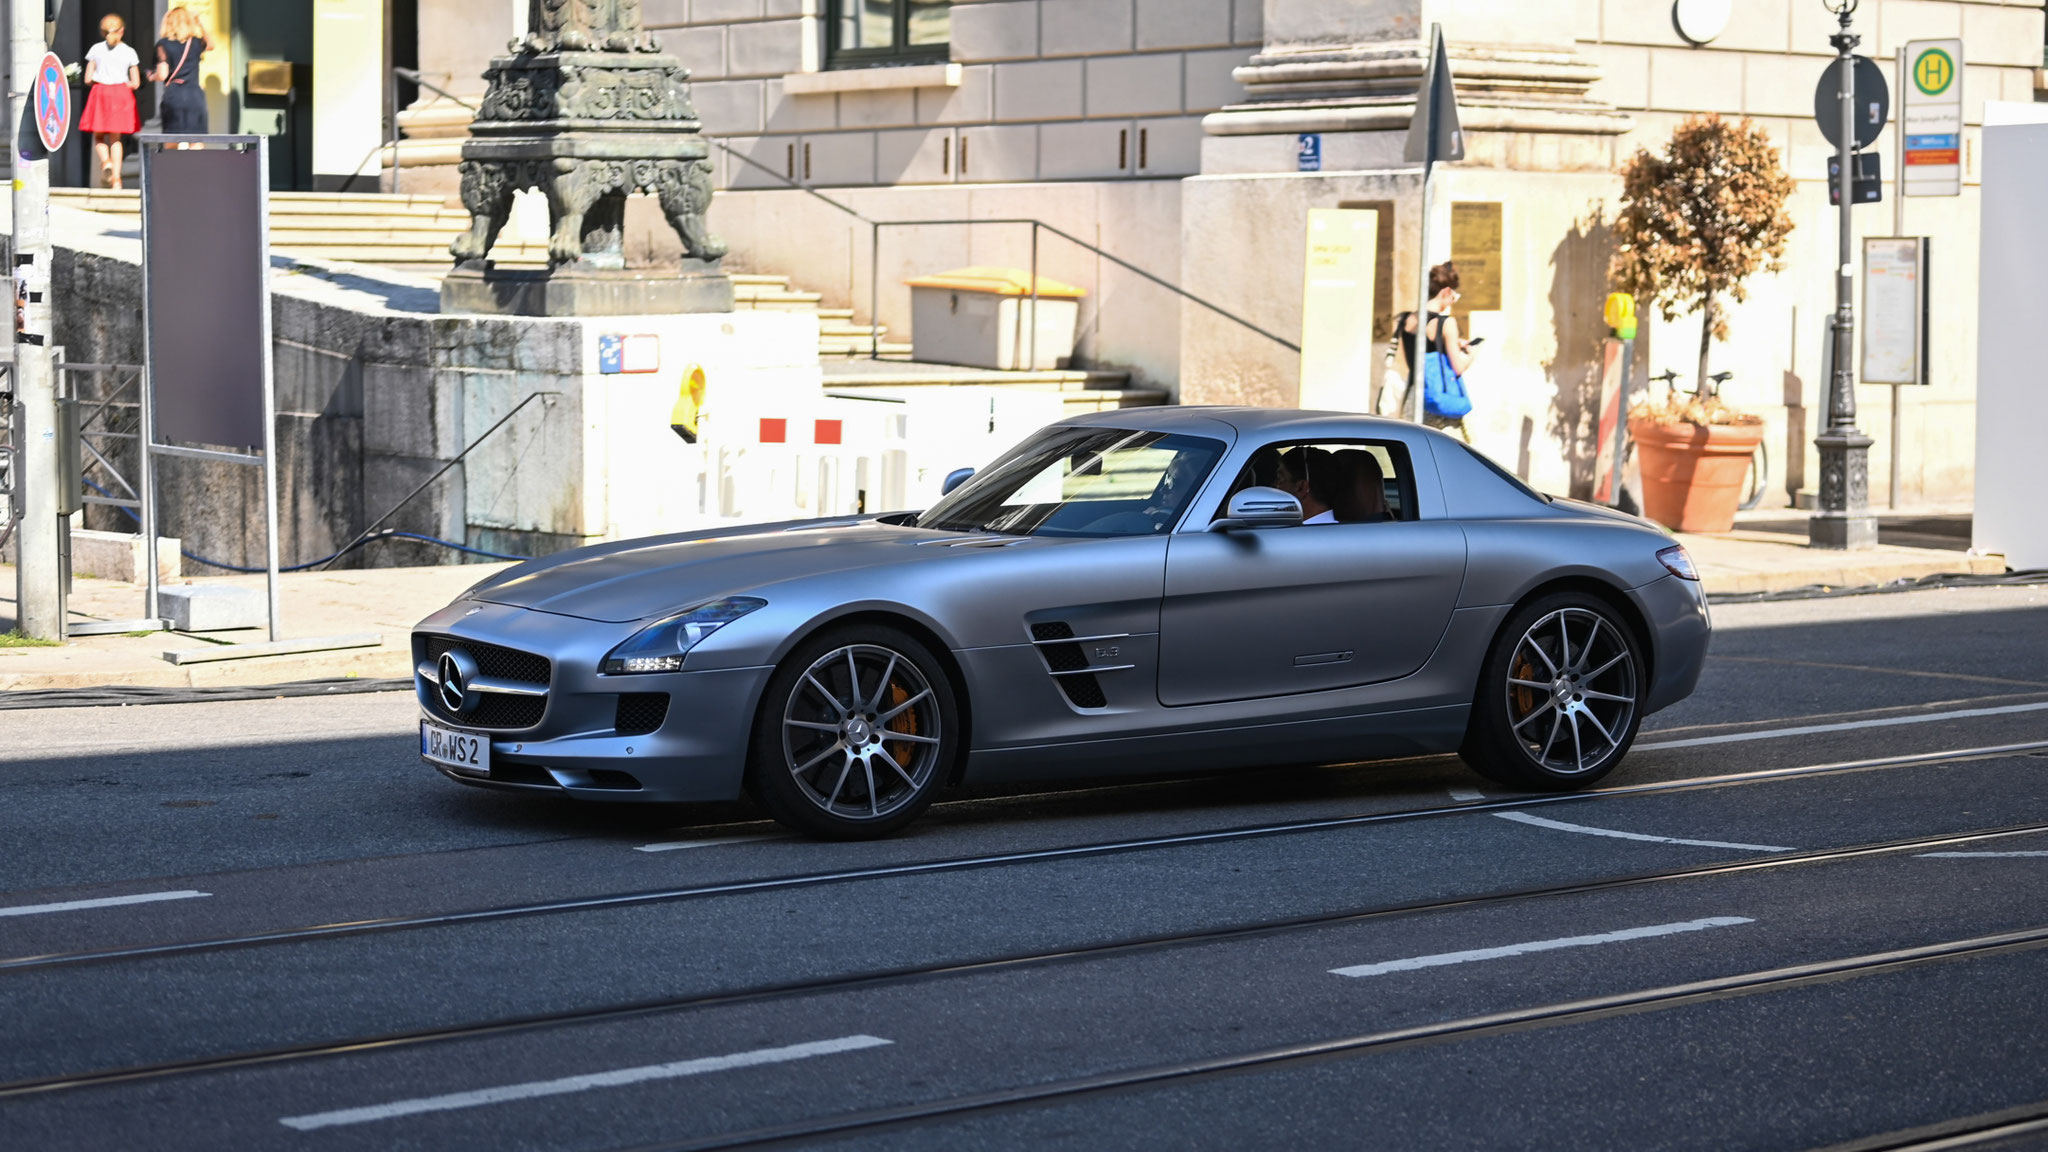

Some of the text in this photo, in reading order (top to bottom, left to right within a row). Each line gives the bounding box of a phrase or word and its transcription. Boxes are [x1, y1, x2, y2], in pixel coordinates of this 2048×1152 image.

[1925, 59, 1942, 85] H
[1303, 136, 1314, 154] 2
[449, 735, 466, 762] WS
[470, 738, 479, 765] 2
